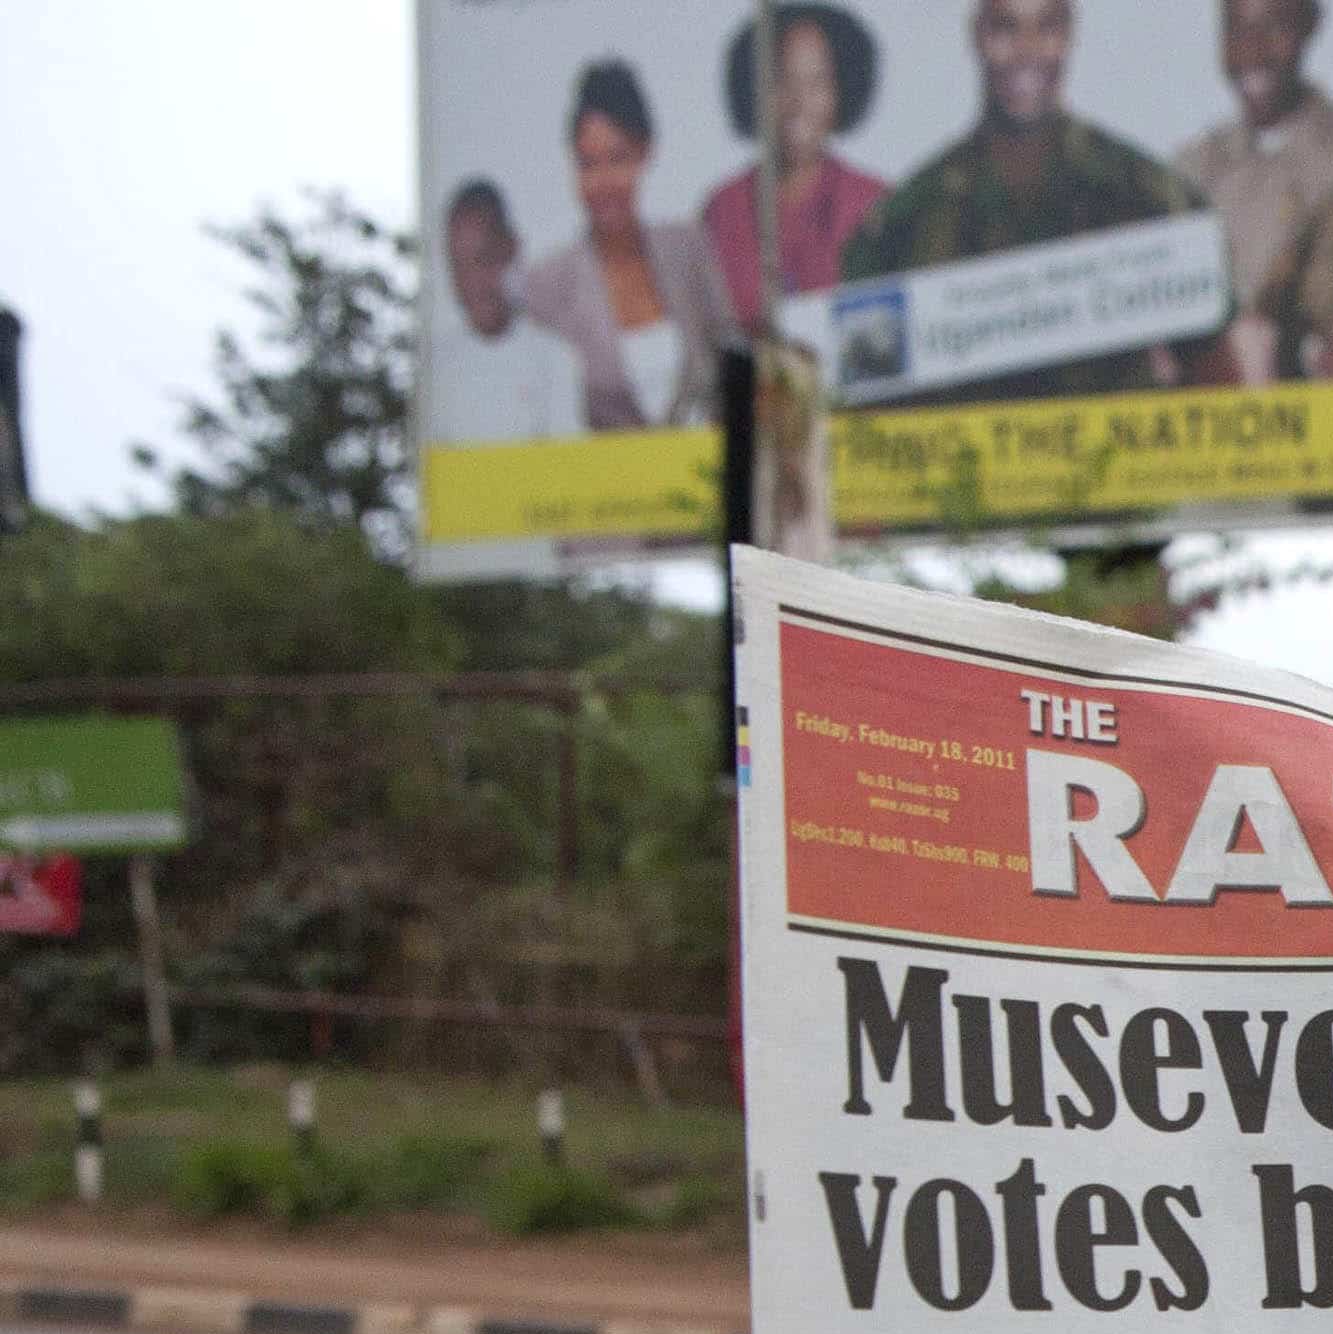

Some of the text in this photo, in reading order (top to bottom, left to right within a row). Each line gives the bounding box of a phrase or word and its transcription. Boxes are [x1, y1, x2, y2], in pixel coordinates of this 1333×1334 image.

[1109, 402, 1307, 451] NATION
[796, 711, 1015, 770] Friday, February 18, 2011
[1020, 688, 1119, 744] THE
[817, 1157, 1210, 1312] votes
